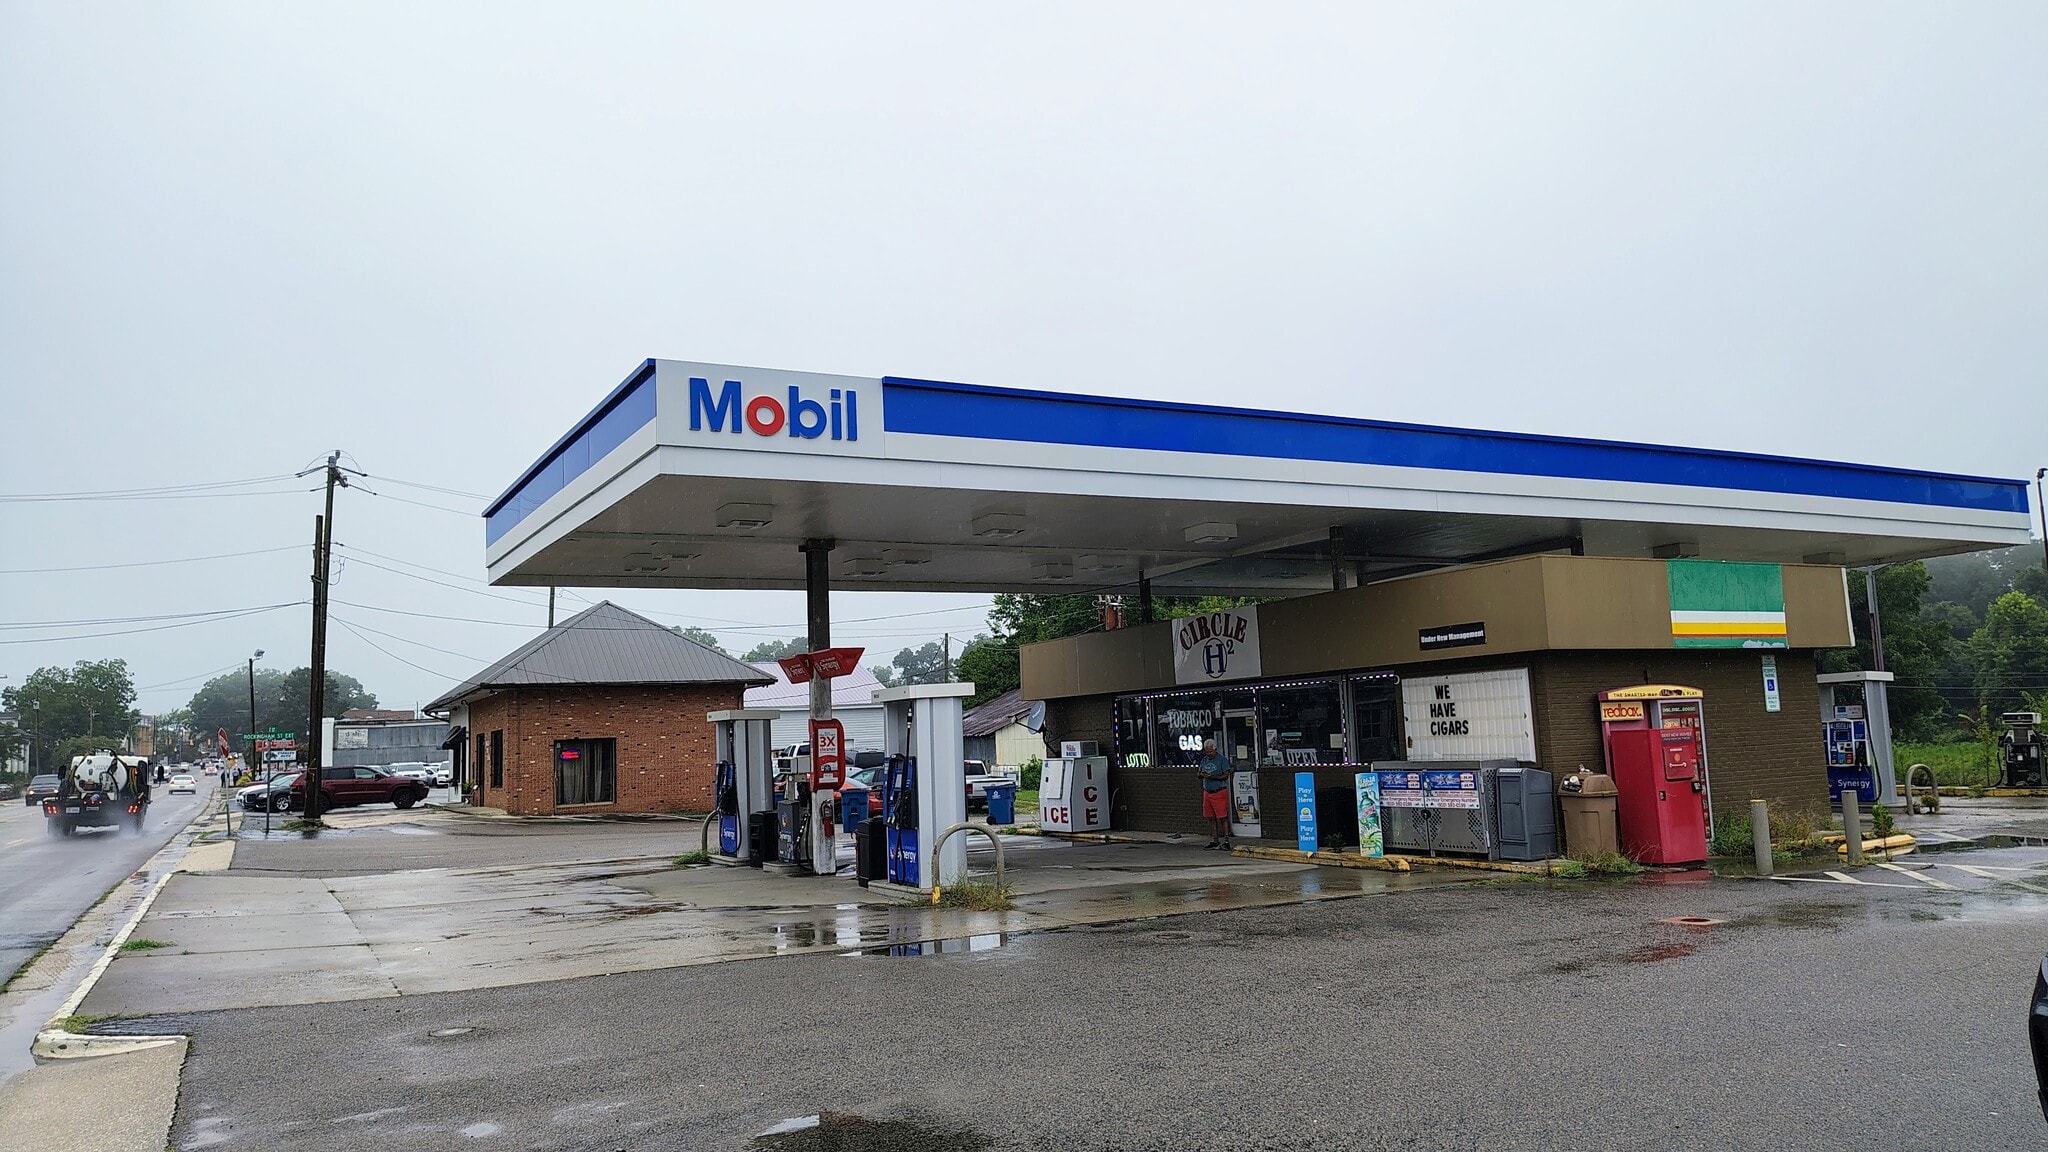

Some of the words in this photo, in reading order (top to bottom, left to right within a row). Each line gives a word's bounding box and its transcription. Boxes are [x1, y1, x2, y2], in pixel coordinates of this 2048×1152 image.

[689, 377, 857, 441] Mobil
[1180, 612, 1248, 650] CIRCLE
[1437, 634, 1448, 642] New
[1448, 630, 1484, 640] Management
[1434, 685, 1450, 699] WE
[1430, 702, 1456, 718] HAVE
[1167, 709, 1212, 728] TOBACCO
[1430, 720, 1469, 736] CIGARS
[820, 736, 835, 747] 3X
[1179, 735, 1203, 751] GAS
[1126, 753, 1149, 767] LOTTO
[1287, 752, 1318, 764] OPEN
[1083, 763, 1099, 826] ICE
[1298, 787, 1312, 795] Play
[1043, 806, 1069, 824] ICE
